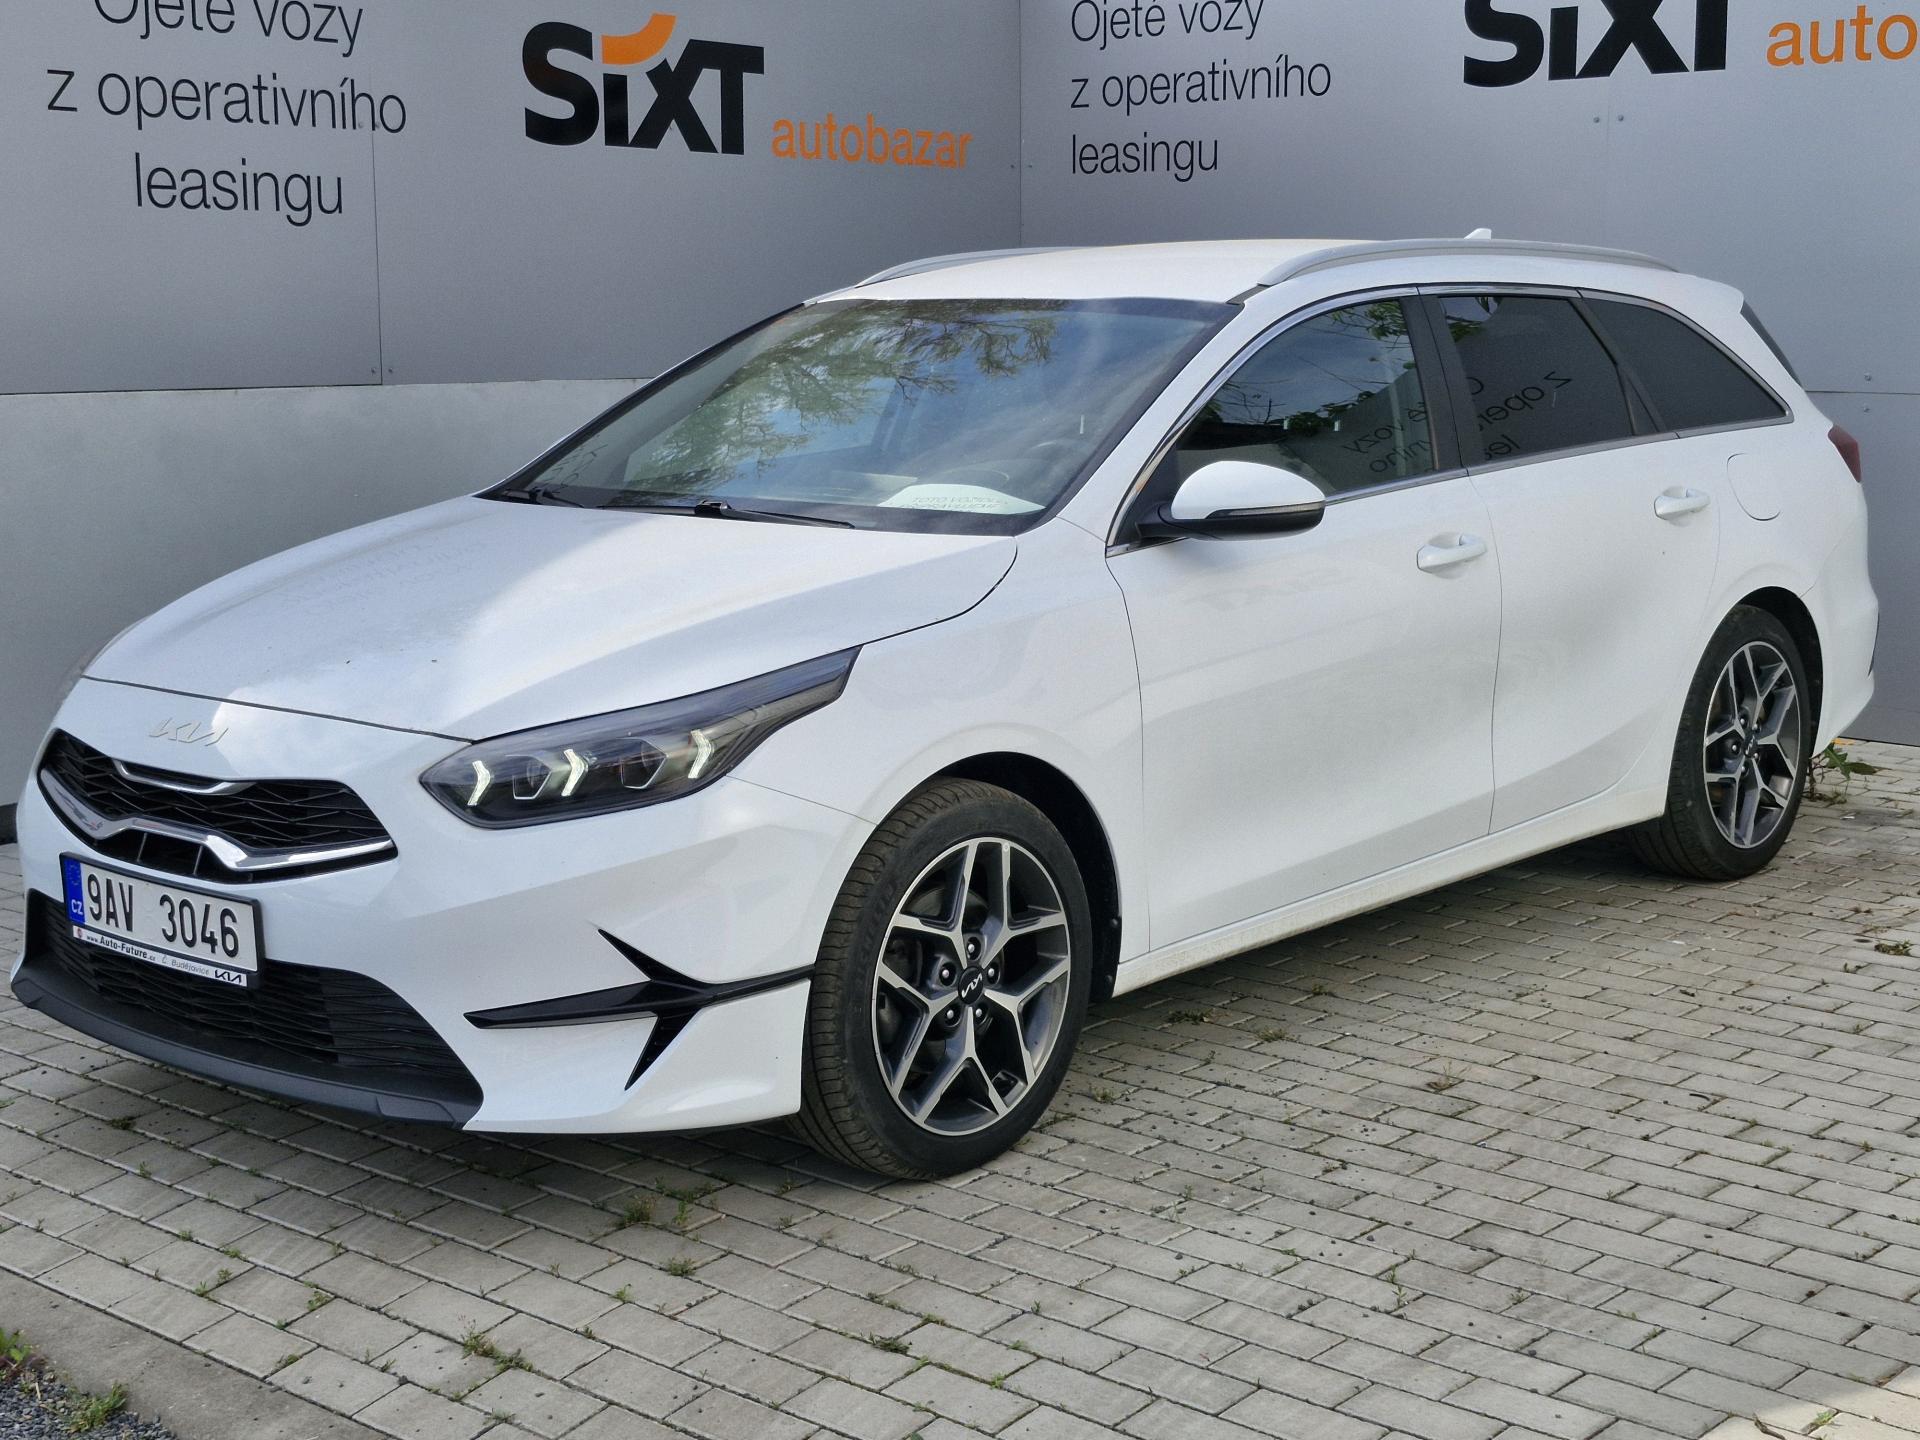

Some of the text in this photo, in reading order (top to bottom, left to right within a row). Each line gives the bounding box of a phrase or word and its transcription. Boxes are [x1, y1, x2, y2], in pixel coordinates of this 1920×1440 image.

[253, 0, 363, 57] vozy
[1178, 0, 1265, 40] vozy
[46, 68, 407, 134] z operativního
[1070, 53, 1332, 117] z operativního
[772, 112, 974, 169] autobazar
[1072, 131, 1219, 183] leasingu
[134, 151, 344, 227] leasingu
[71, 899, 84, 916] CZ
[87, 873, 240, 958] 9AV 3046
